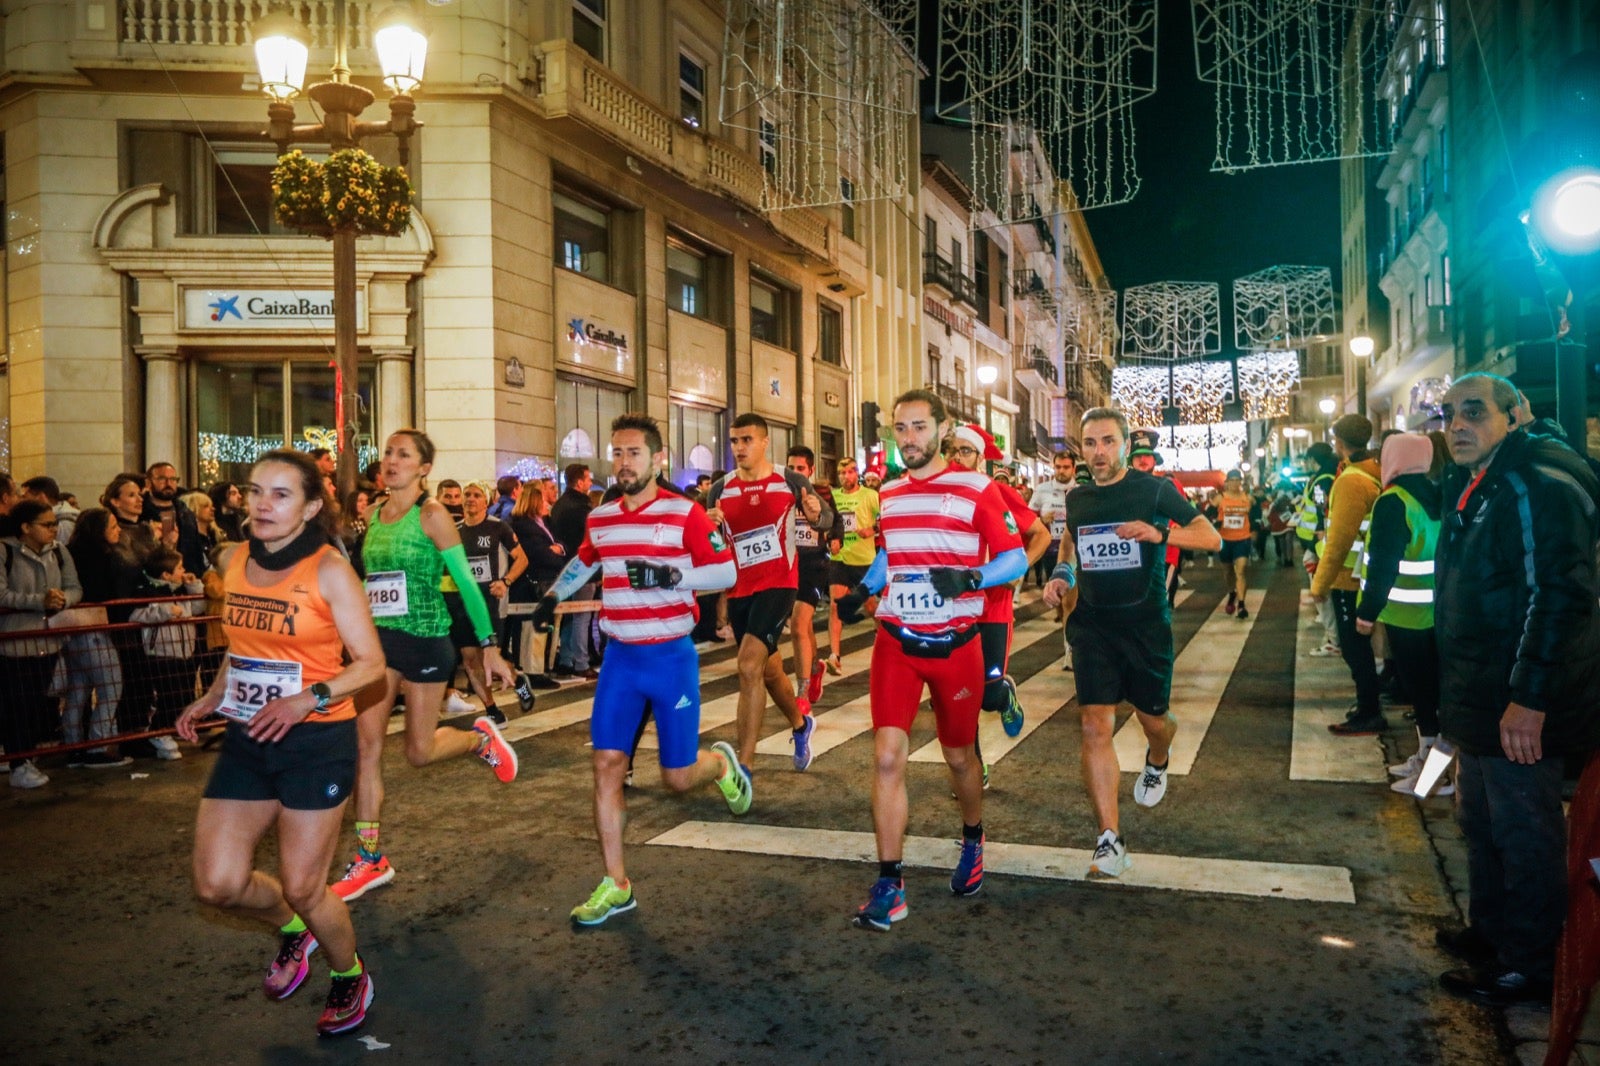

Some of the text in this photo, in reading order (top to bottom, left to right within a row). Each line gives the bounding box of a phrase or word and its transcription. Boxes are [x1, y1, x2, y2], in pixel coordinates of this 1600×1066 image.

[742, 539, 771, 557] 763
[1086, 541, 1131, 557] 1289
[368, 589, 399, 603] 1180
[236, 681, 283, 706] 528
